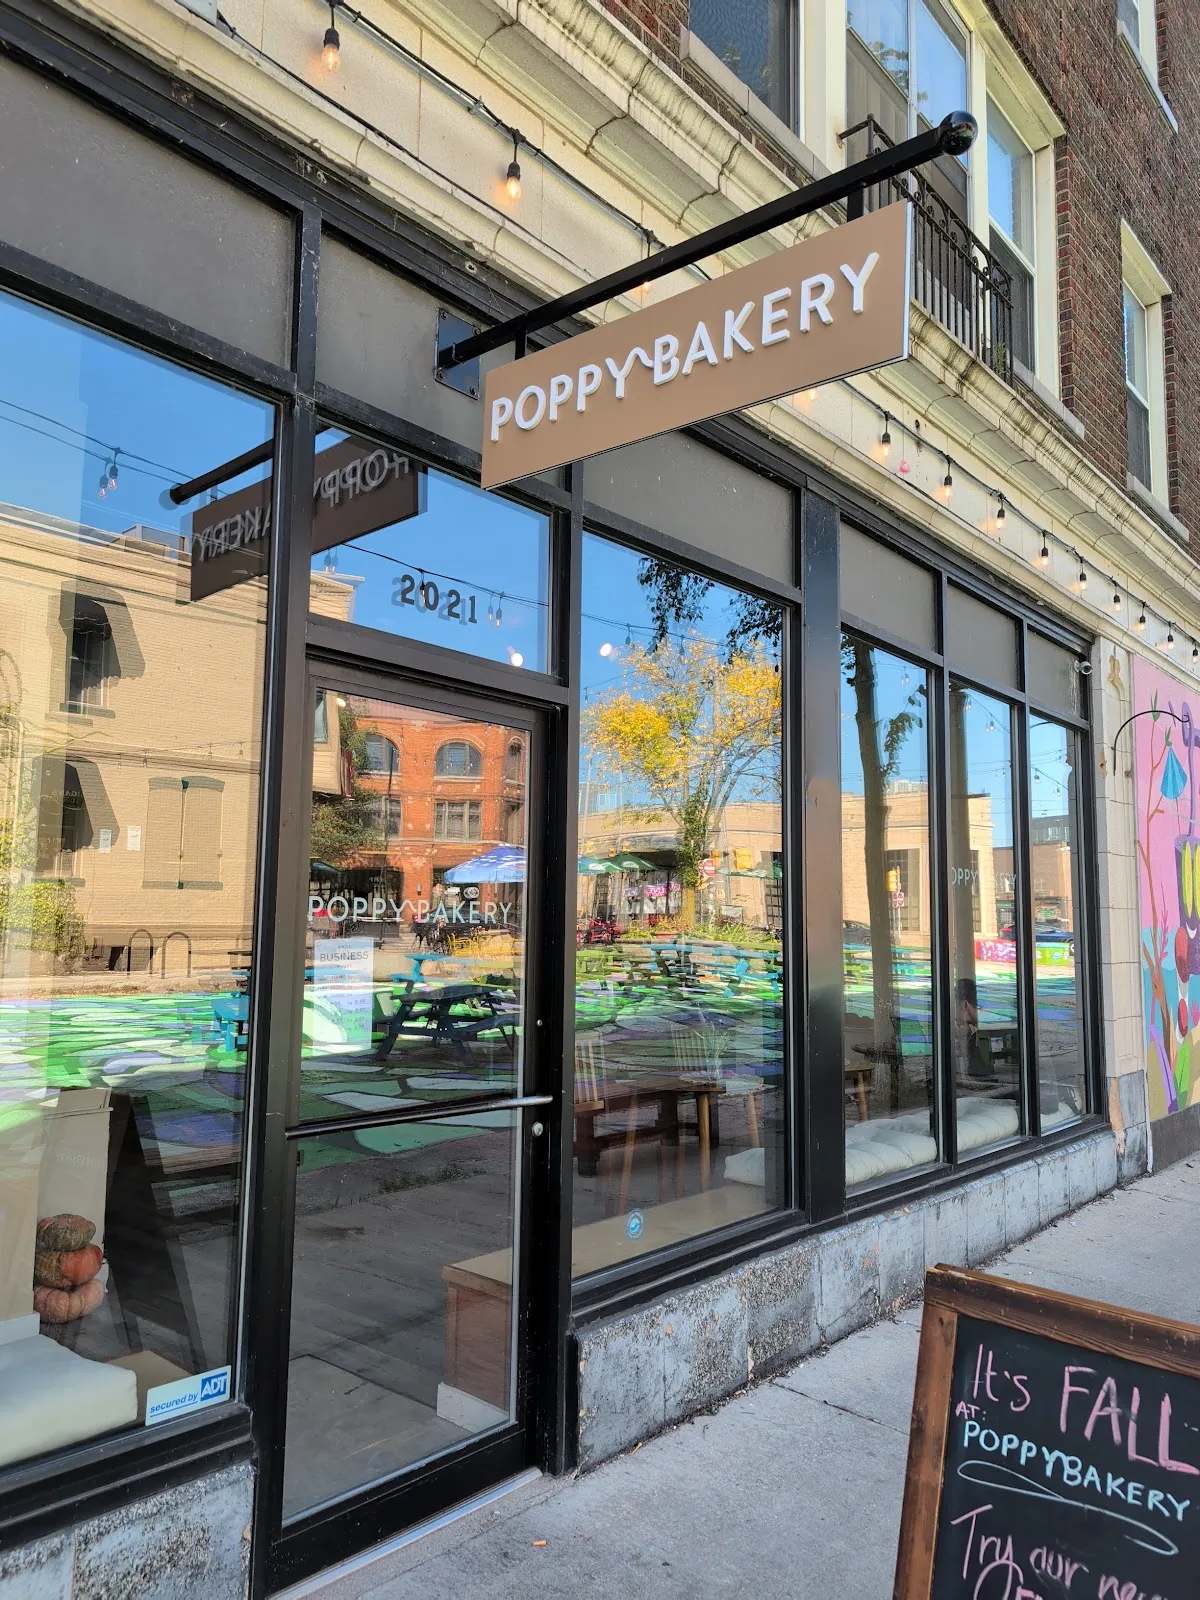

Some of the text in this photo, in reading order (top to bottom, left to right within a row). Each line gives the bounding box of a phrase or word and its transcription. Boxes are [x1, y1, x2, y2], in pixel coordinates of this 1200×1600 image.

[400, 574, 477, 624] 2021
[320, 950, 369, 961] BUSINESS
[150, 1375, 227, 1413] secured by ADT
[1060, 1366, 1200, 1474] FALL
[951, 1504, 1014, 1600] Try
